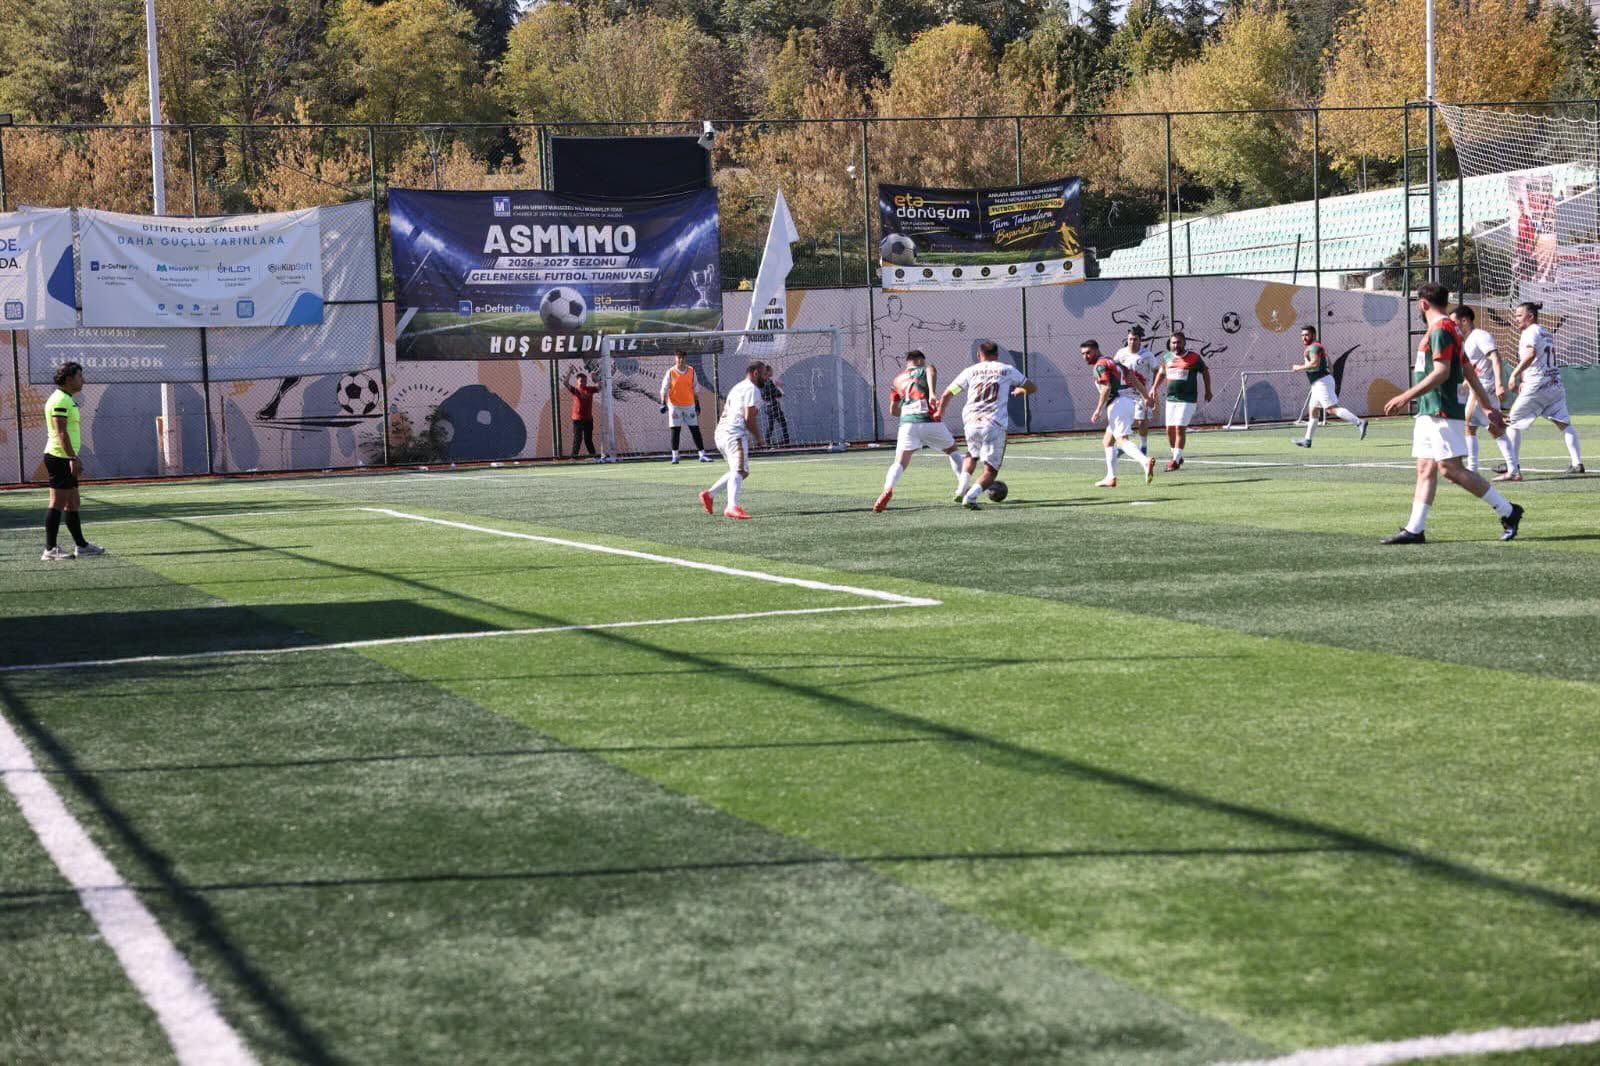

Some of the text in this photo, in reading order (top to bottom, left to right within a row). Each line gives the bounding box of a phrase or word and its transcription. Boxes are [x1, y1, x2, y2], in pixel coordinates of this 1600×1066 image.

[894, 193, 924, 207] eta
[896, 205, 970, 221] dönüşüm
[990, 218, 1010, 232] Tüm
[118, 236, 153, 246] DAHA
[214, 236, 284, 246] YARINLARA
[483, 224, 637, 254] ASMMMO
[508, 258, 534, 267] 2026
[544, 258, 569, 267] 2027
[572, 258, 617, 267] SEZONU
[472, 271, 653, 281] GELENEKSEL FUTBOL TURNUVASI
[475, 303, 530, 313] e-Defter Pro
[490, 335, 530, 357] HOŞ
